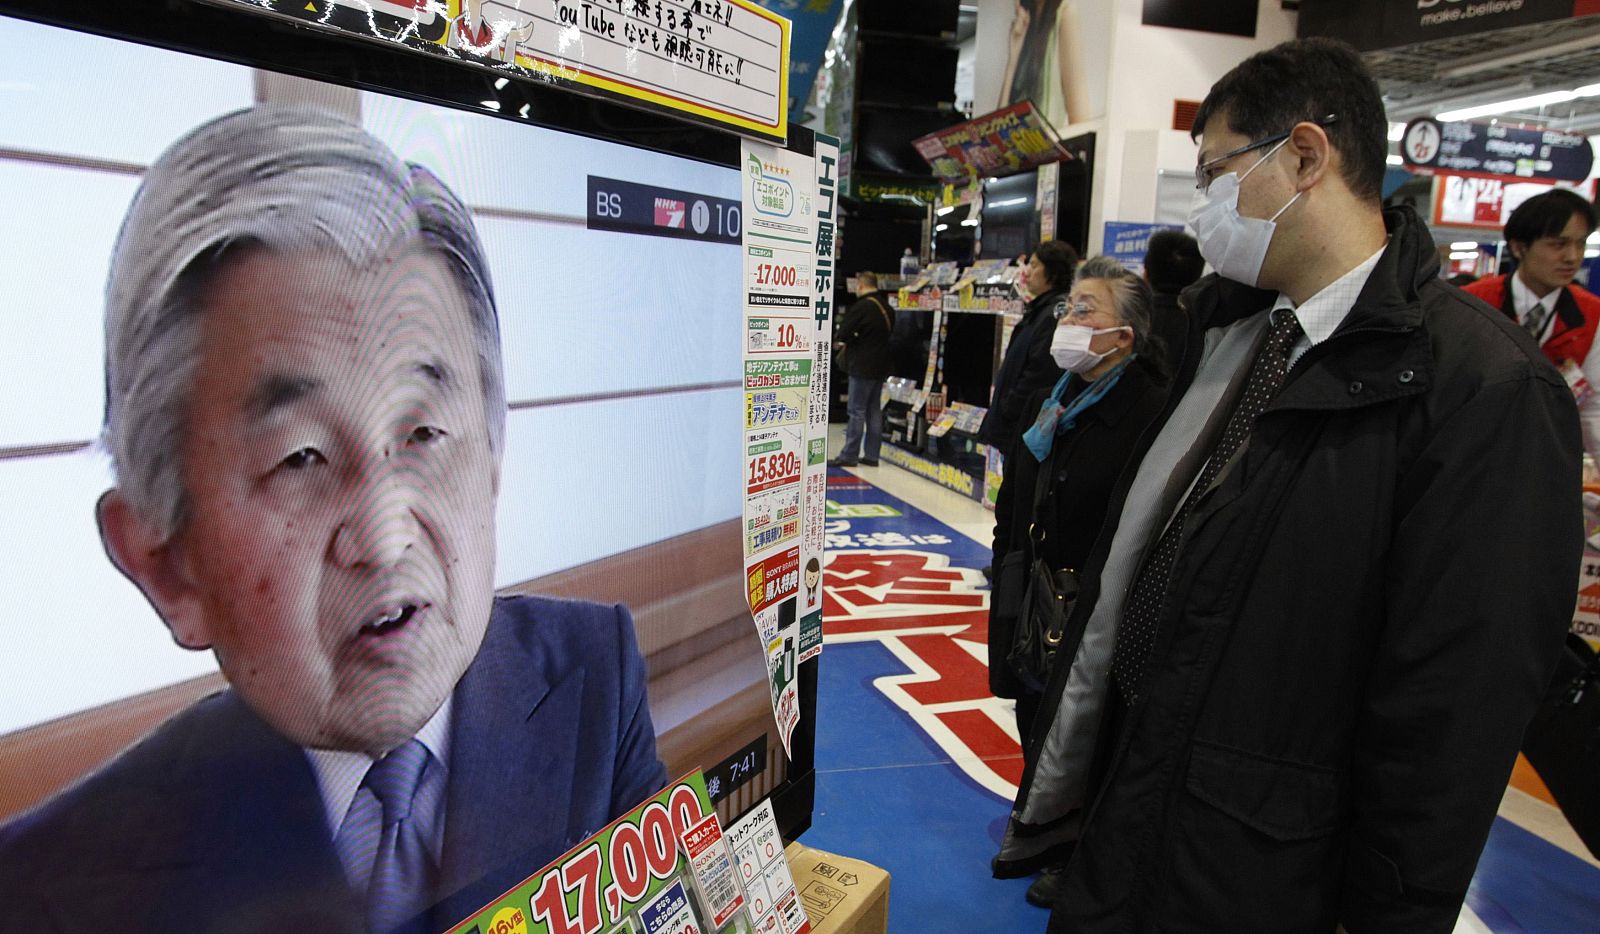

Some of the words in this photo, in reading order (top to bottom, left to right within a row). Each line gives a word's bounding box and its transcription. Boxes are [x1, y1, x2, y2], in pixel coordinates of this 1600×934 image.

[757, 181, 790, 198] エコポイント
[596, 191, 622, 218] BS
[654, 197, 677, 210] NHK
[815, 154, 836, 331] エコ展示中
[777, 324, 803, 349] 10%
[753, 403, 799, 424] アンテナセット
[765, 570, 799, 603] 購入特典
[706, 776, 720, 798] 後
[730, 751, 755, 782] 7:41
[687, 820, 717, 847] ご購入カード
[531, 784, 703, 934] 17,000
[695, 849, 717, 870] SONY
[649, 896, 685, 932] こちらの商品
[655, 895, 671, 912] 今なら
